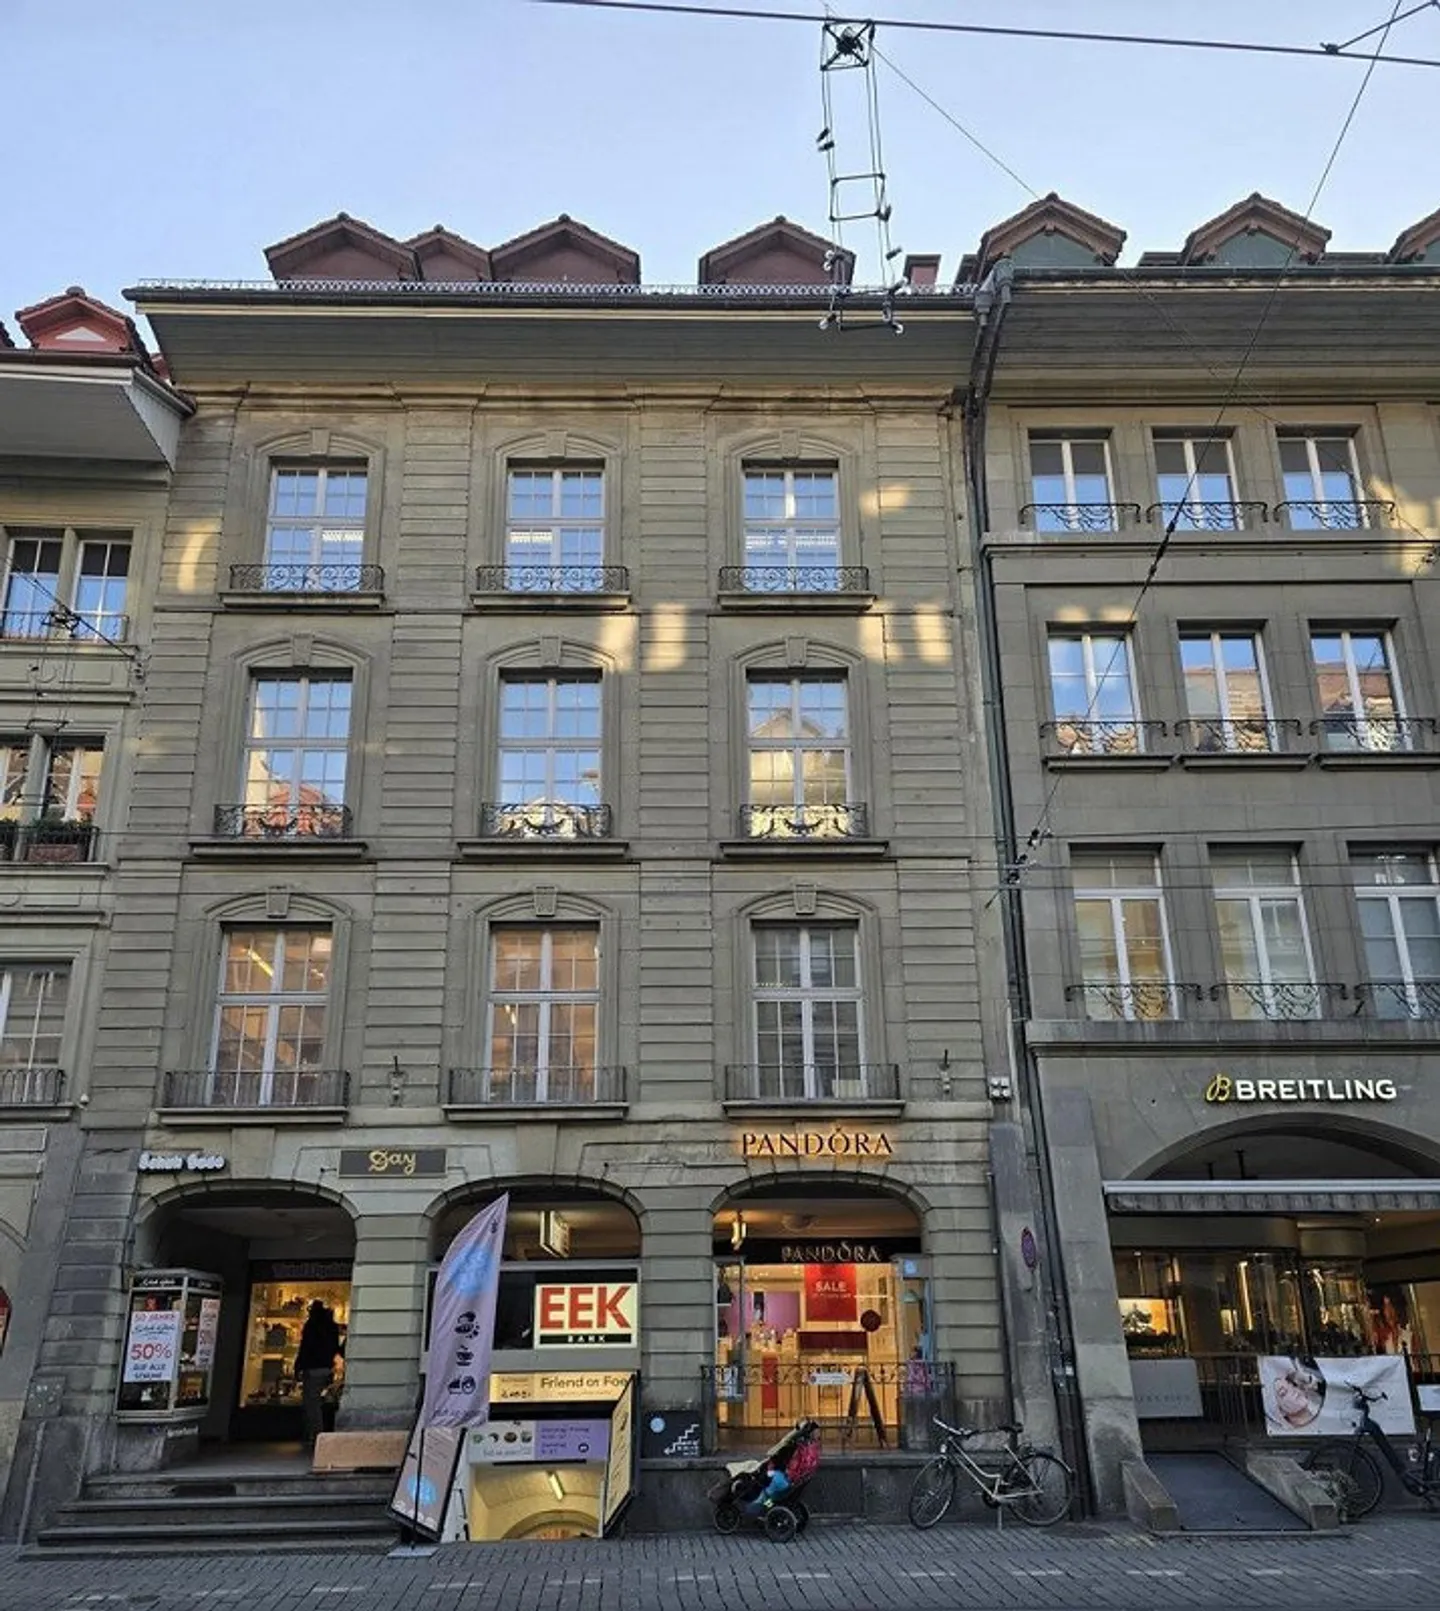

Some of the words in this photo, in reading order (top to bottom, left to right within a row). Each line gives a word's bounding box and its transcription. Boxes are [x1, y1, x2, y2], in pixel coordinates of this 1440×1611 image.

[1236, 1079, 1397, 1100] BREITLING
[742, 1127, 893, 1155] PANDORA
[781, 1242, 881, 1262] PANDORA
[815, 1281, 847, 1292] SALE
[540, 1285, 632, 1329] EEK
[568, 1335, 606, 1343] BANK
[130, 1343, 172, 1360] 50%
[541, 1376, 584, 1389] Friend
